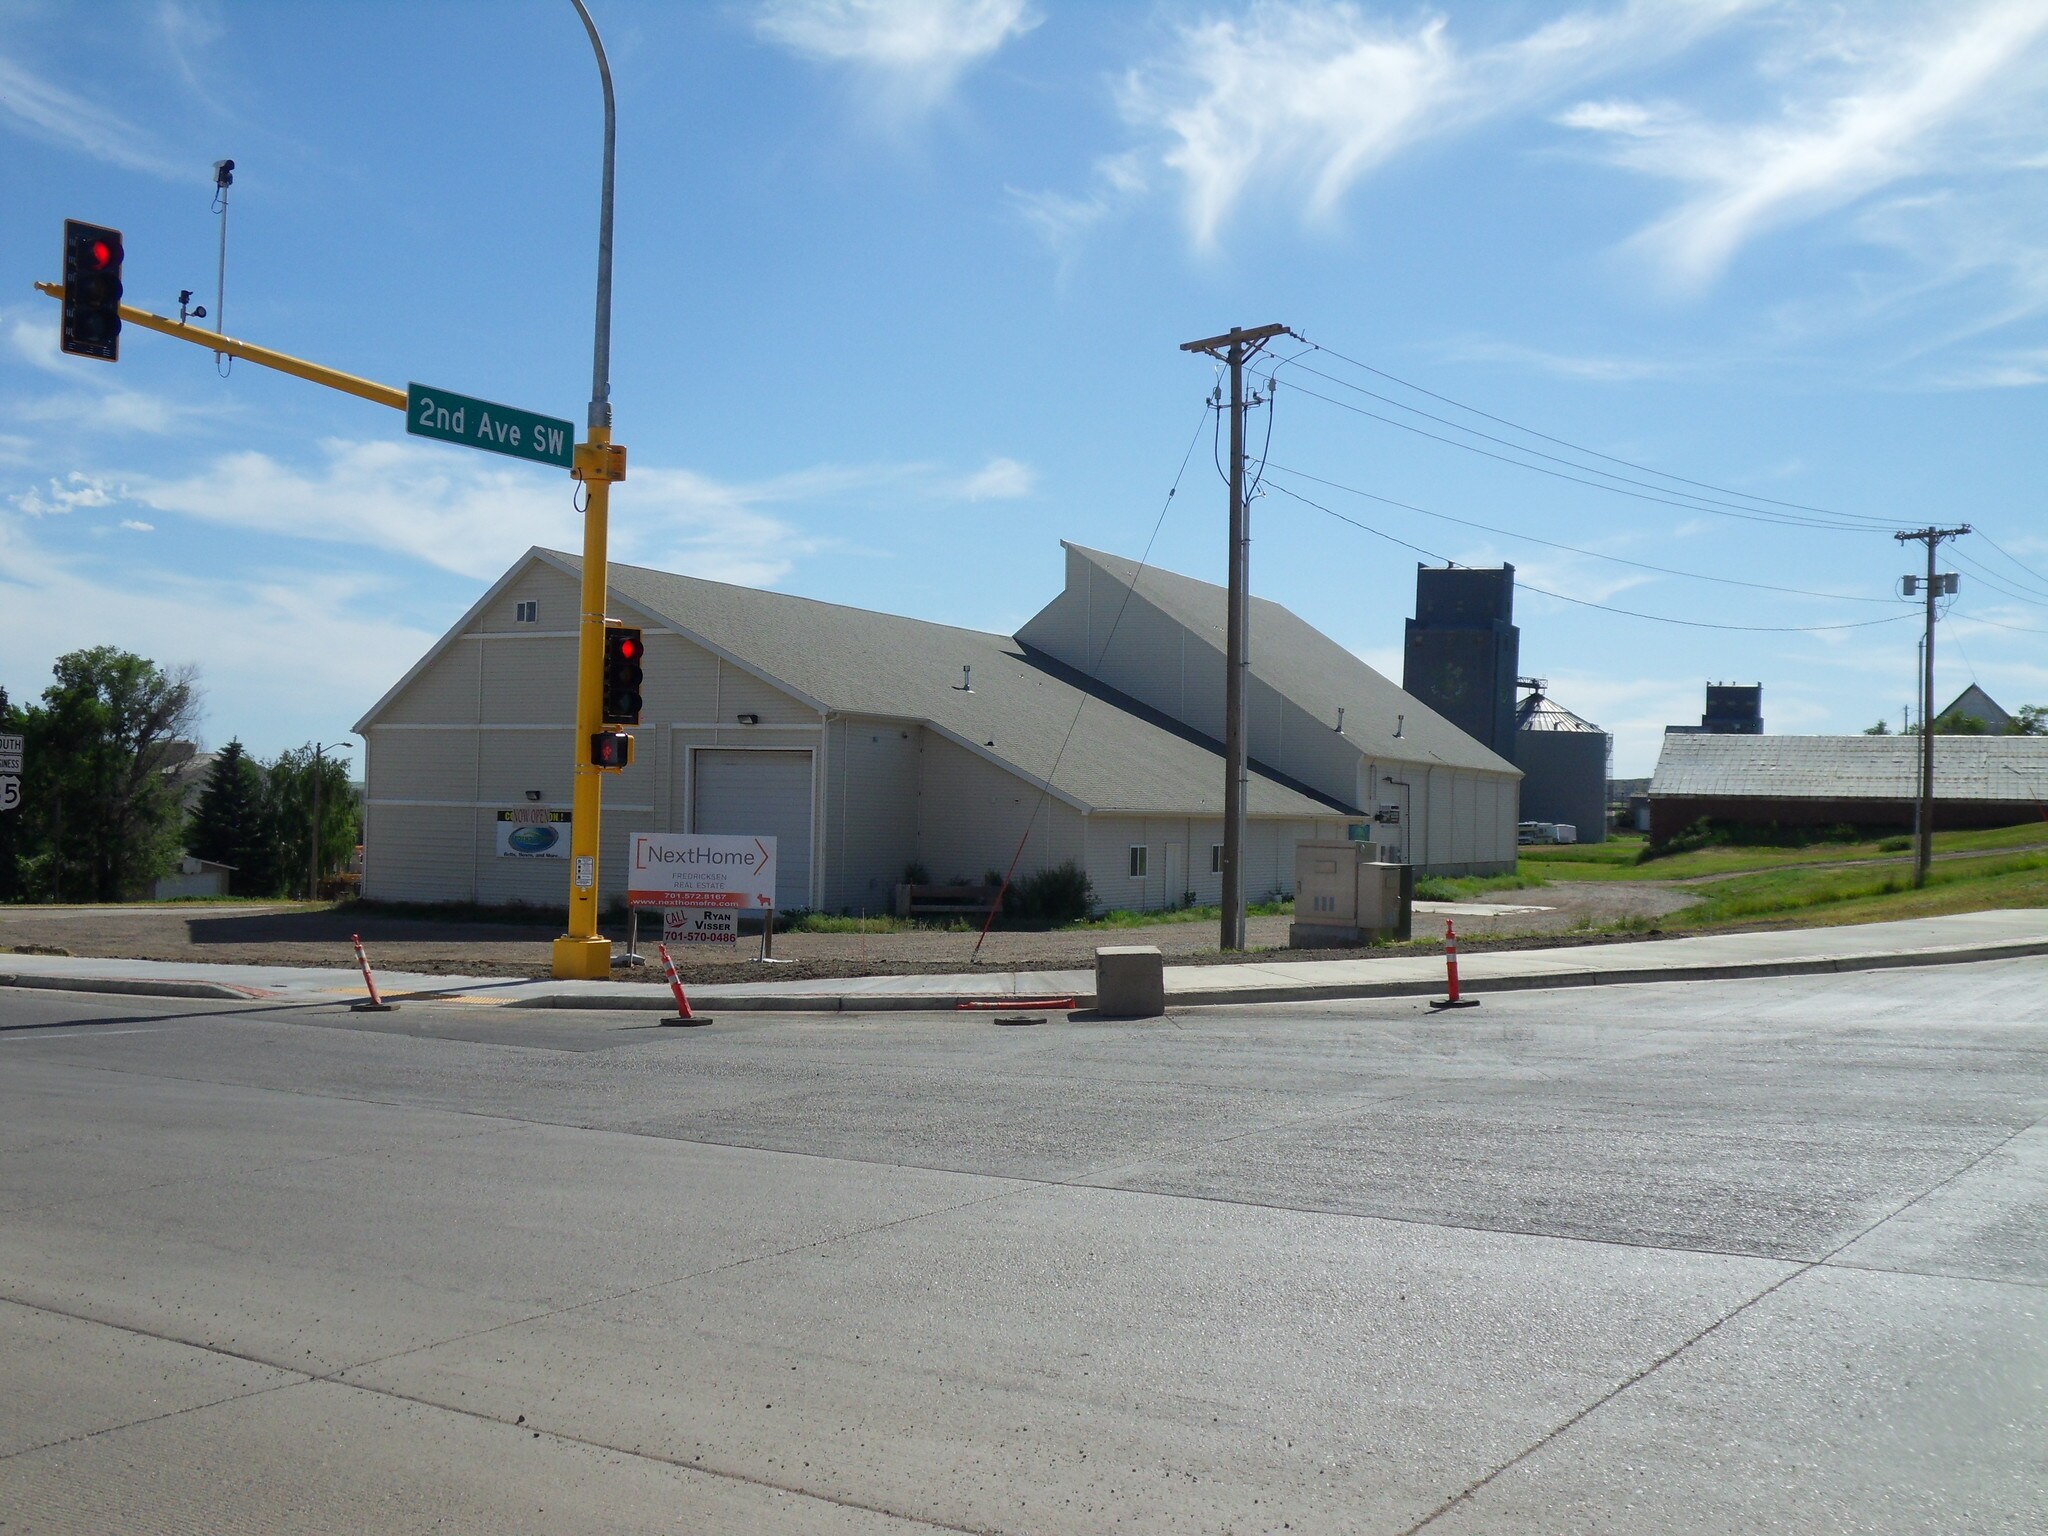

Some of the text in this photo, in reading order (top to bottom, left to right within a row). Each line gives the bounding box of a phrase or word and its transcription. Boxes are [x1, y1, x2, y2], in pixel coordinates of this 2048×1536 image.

[419, 397, 564, 456] 2nd Ave SW
[0, 783, 18, 804] 5
[513, 808, 529, 823] NOW
[531, 808, 549, 824] OPEN
[648, 845, 755, 866] NextHome
[672, 872, 727, 880] FREDRICKSEN
[673, 881, 725, 890] REAL ESTATE
[665, 909, 688, 925] CALL
[704, 911, 731, 921] RYAN
[695, 920, 731, 931] VISSER
[664, 931, 736, 943] 701-570-0486
